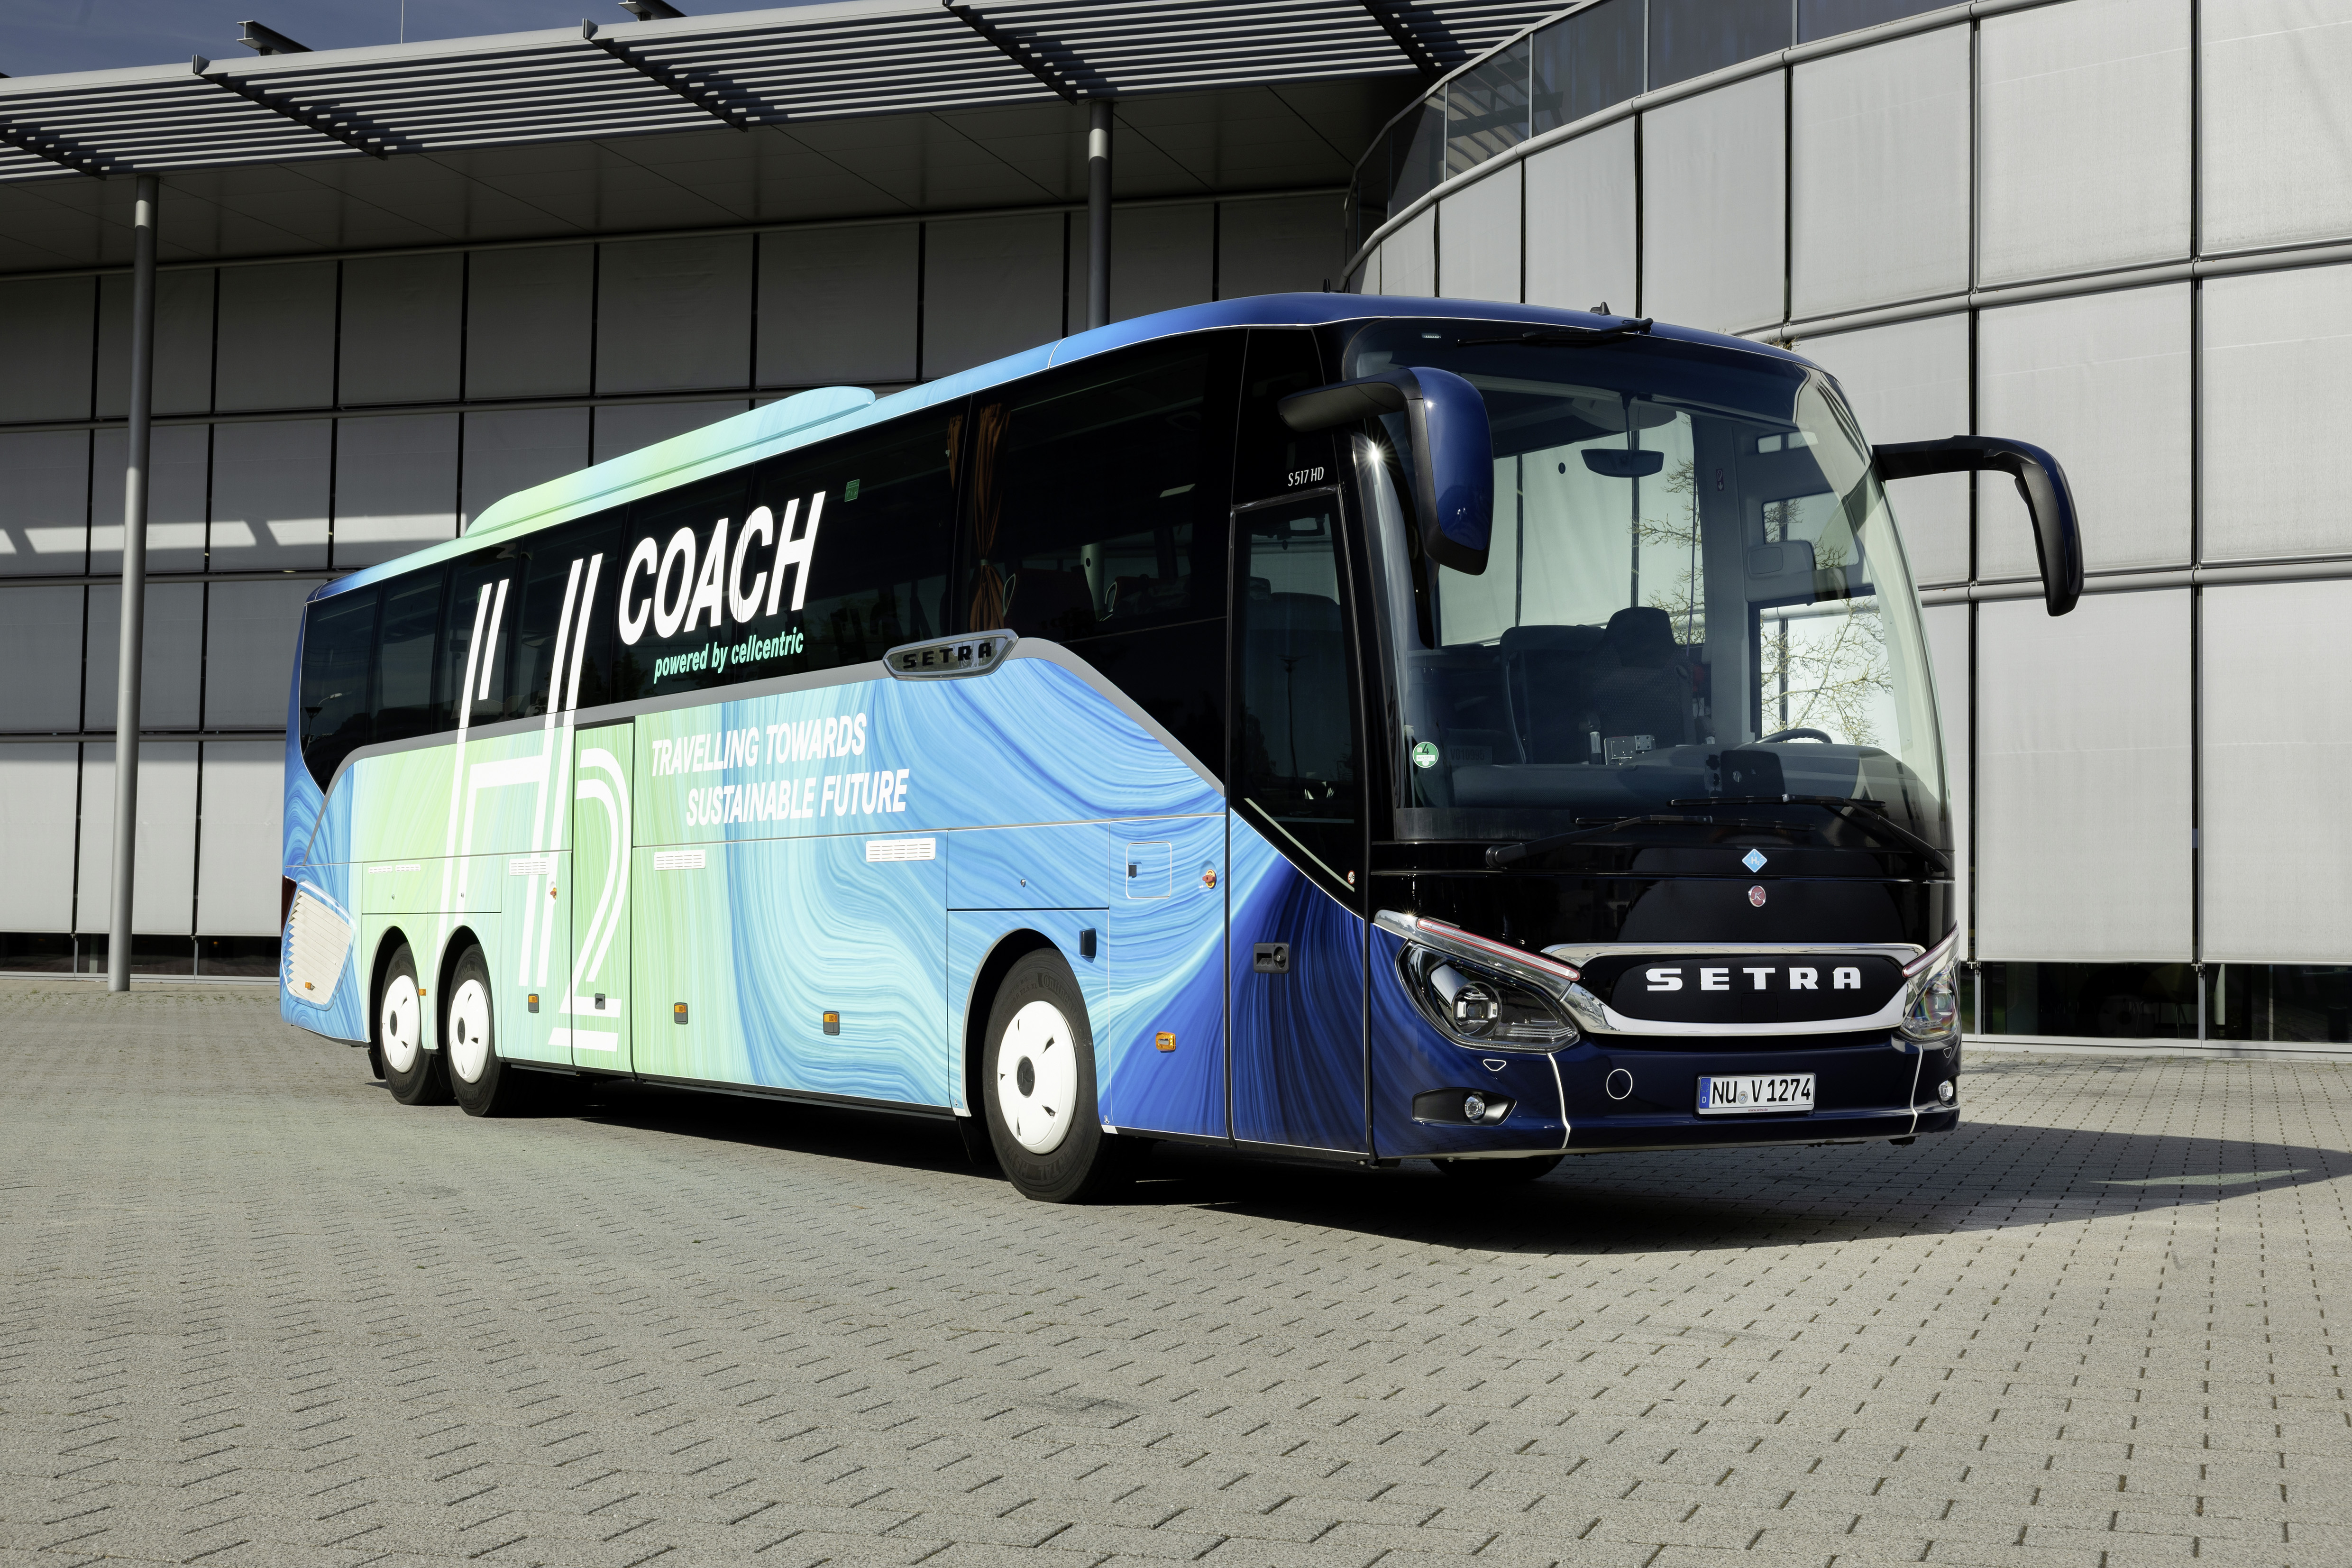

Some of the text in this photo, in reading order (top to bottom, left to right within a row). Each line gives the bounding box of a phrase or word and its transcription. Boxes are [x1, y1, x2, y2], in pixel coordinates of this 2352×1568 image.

[1288, 467, 1324, 486] S 517 HD
[619, 491, 826, 645] COACH
[654, 626, 804, 684] powered by cellcentric
[903, 642, 992, 669] SETRA
[652, 712, 867, 777] TRAVELLING TOWARDS
[1422, 743, 1429, 755] 4
[686, 768, 909, 826] SUSTAINABLE FUTURE
[1645, 967, 1861, 991] SETRA
[1712, 1078, 1811, 1104] NU V 1274
